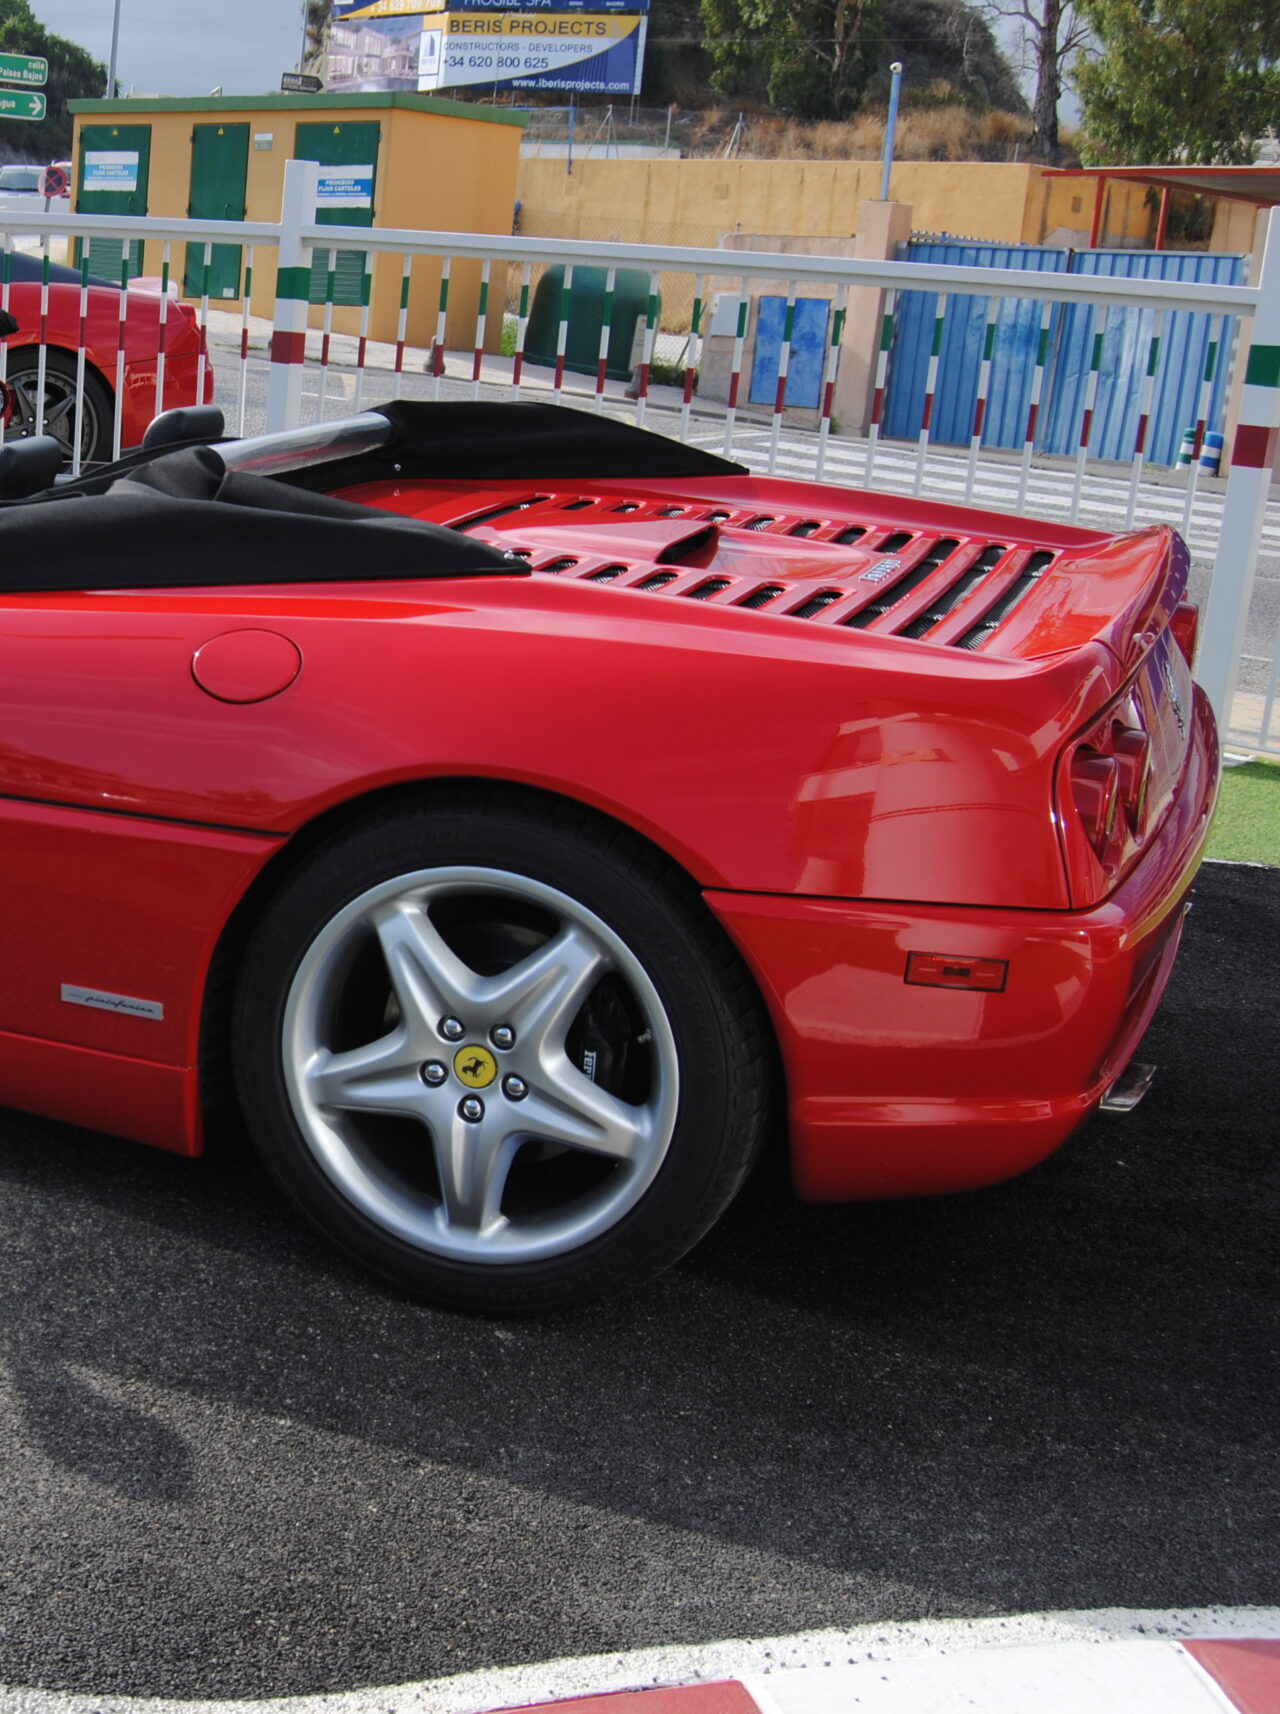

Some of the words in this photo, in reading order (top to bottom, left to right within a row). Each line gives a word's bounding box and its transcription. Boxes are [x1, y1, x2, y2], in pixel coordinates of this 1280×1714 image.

[510, 20, 607, 35] PROJECTS
[443, 42, 520, 52] CONSTRUCTORS
[528, 43, 593, 53] DEVELOPERS
[28, 61, 45, 70] calle
[469, 57, 493, 68] 620
[496, 57, 521, 68] 800
[524, 57, 549, 69] 625
[23, 70, 43, 81] Bajos
